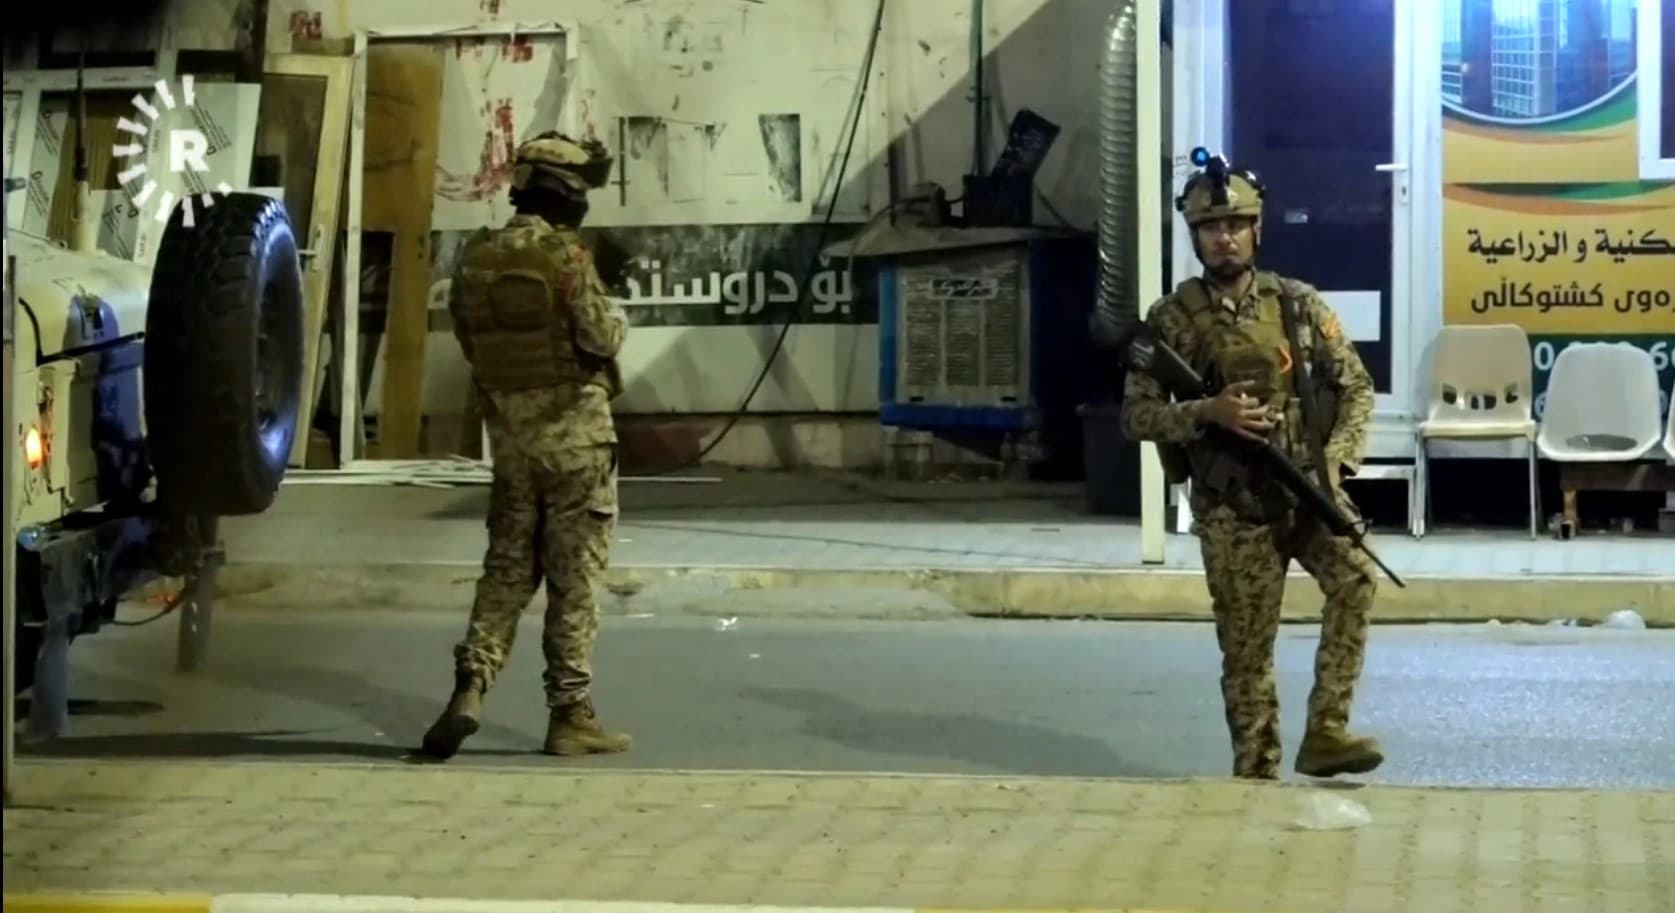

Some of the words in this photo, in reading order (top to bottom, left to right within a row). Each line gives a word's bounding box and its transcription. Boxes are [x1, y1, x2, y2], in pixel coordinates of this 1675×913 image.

[1467, 229, 1567, 264] الزراعية
[1573, 238, 1588, 263] و
[1595, 228, 1675, 263] كنية
